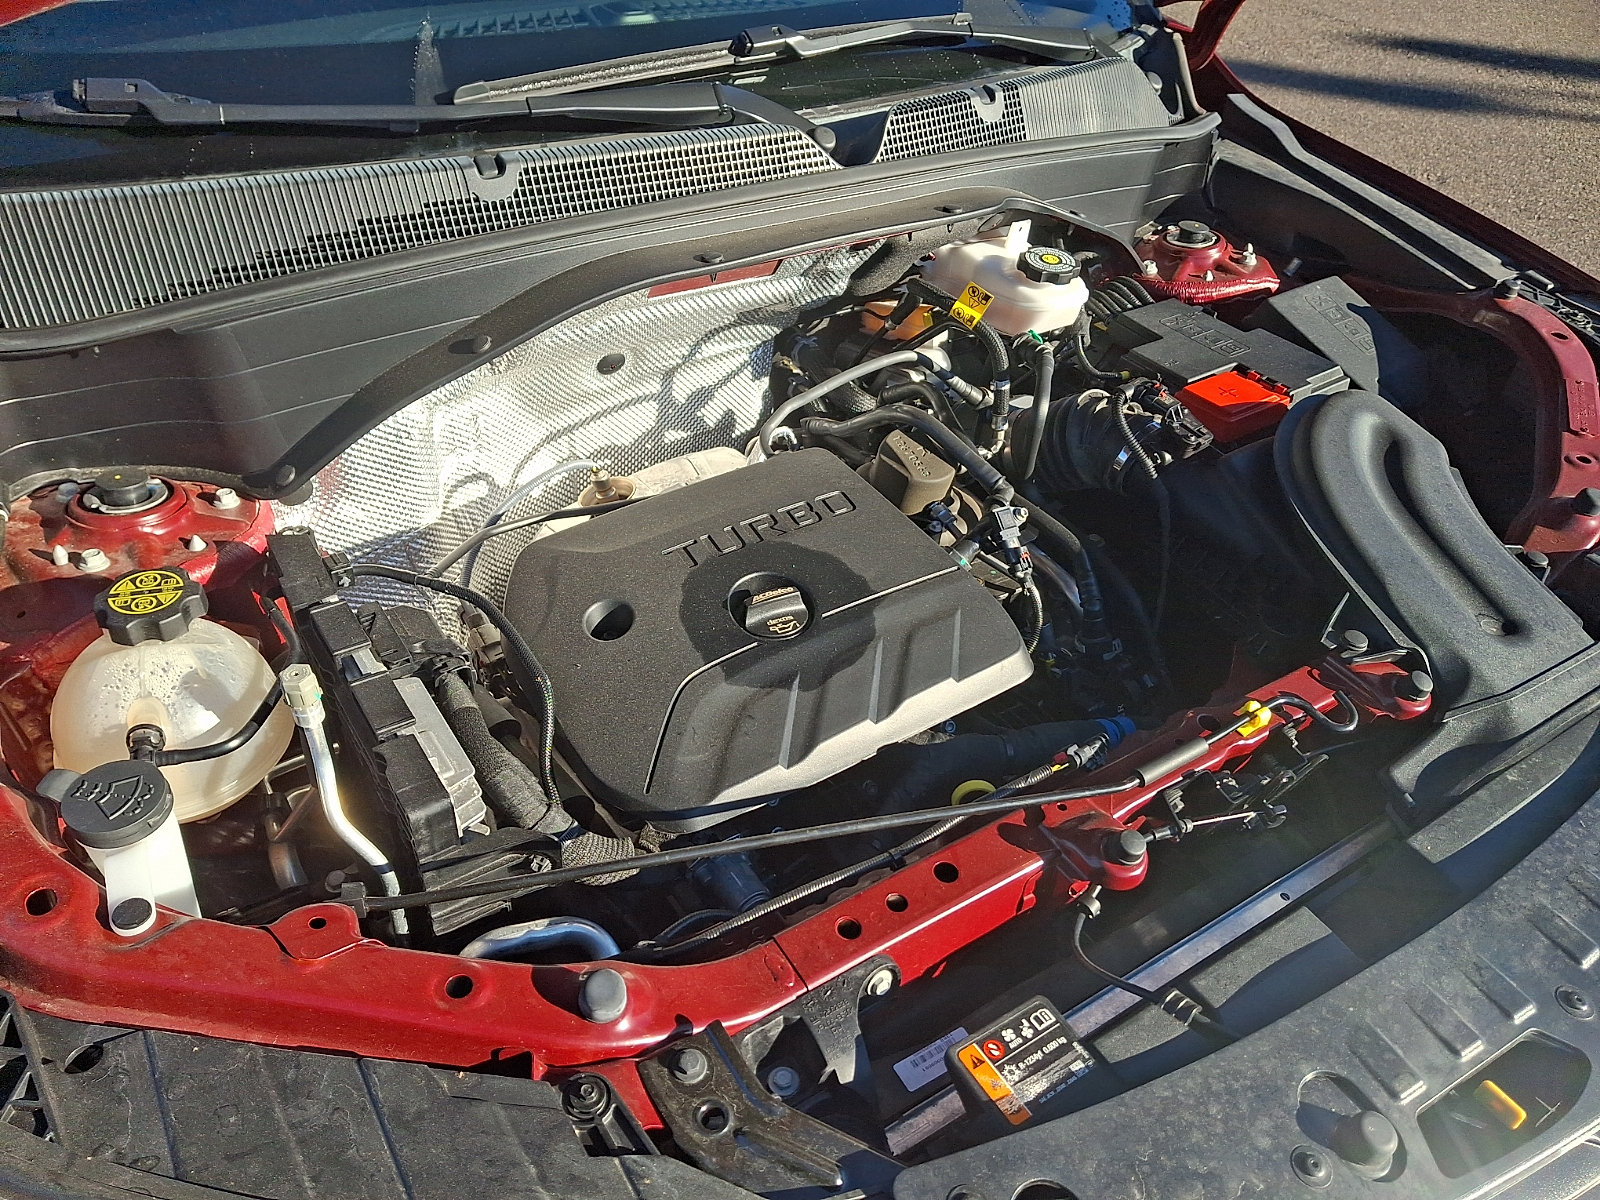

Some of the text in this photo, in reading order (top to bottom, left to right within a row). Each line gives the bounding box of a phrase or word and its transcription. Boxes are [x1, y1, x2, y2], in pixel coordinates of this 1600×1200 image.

[661, 490, 857, 568] TURBO
[752, 587, 794, 605] ACDelco
[1008, 1036, 1023, 1049] AUTO
[1056, 1036, 1068, 1046] kg
